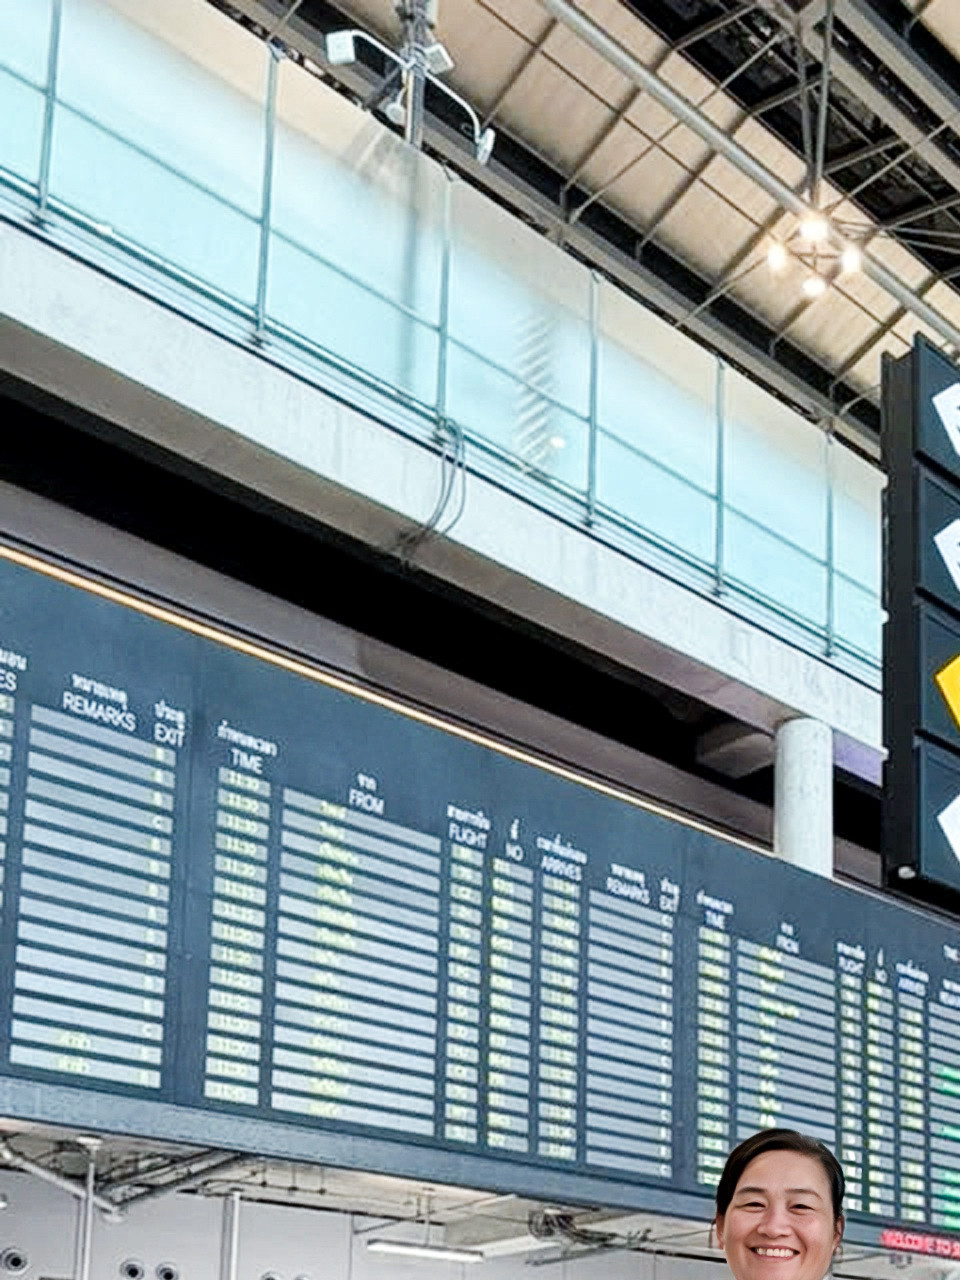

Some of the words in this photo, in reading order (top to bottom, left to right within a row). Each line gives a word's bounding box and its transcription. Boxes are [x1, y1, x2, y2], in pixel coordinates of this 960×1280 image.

[63, 691, 136, 732] REMARKS
[154, 722, 186, 747] EXIT
[231, 748, 264, 775] TIME
[349, 788, 385, 815] FROM
[449, 822, 487, 849] FLIGHT
